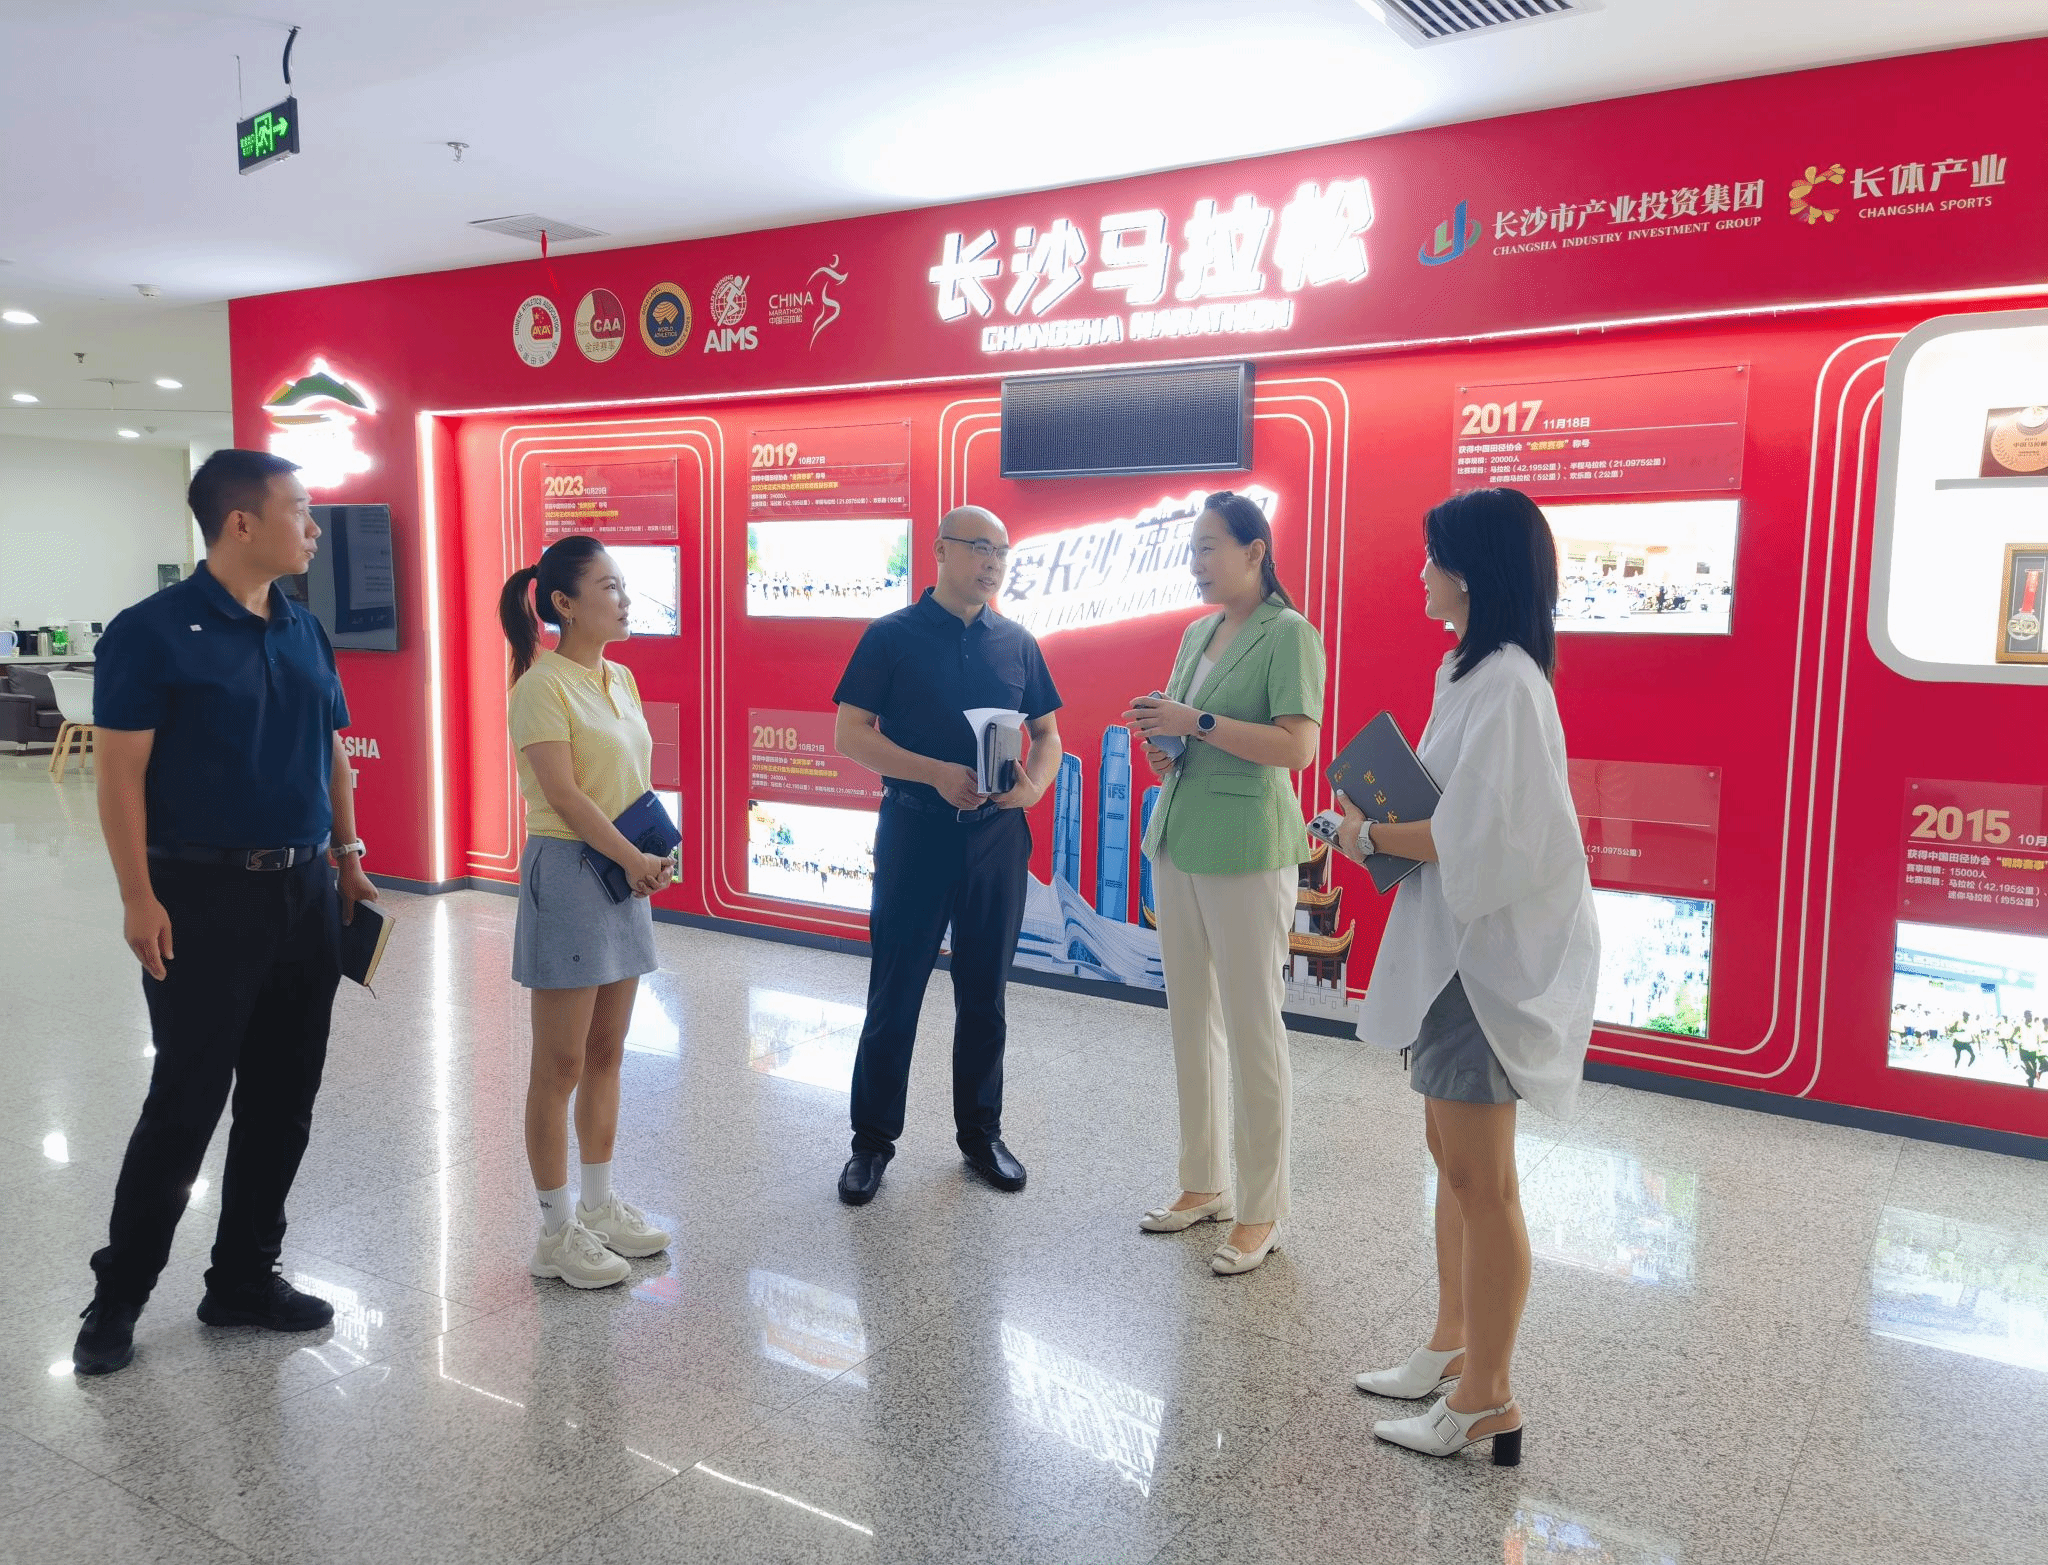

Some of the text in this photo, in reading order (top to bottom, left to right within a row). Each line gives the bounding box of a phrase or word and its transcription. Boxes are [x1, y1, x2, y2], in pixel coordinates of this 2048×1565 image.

[1850, 153, 2007, 199] 长体产业
[1491, 178, 1766, 240] 长沙市产业投资集团
[1858, 195, 1993, 219] CHANGSHA SPORTS
[929, 177, 1374, 321] 长沙马拉松
[1493, 216, 1762, 257] CHANGSHA INDUSTRY INVESTMENT GROUP
[768, 291, 814, 309] CHINA
[768, 307, 803, 317] MARATHON
[593, 317, 621, 333] CAA
[703, 325, 759, 353] AIMS
[981, 300, 1295, 352] CHANGSHA MARATHON
[1460, 400, 1590, 435] 2017 11月18日
[751, 442, 798, 468] 2019
[544, 475, 584, 497] 2023
[752, 725, 825, 753] 2018 10月21日
[1910, 804, 2011, 844] 2015
